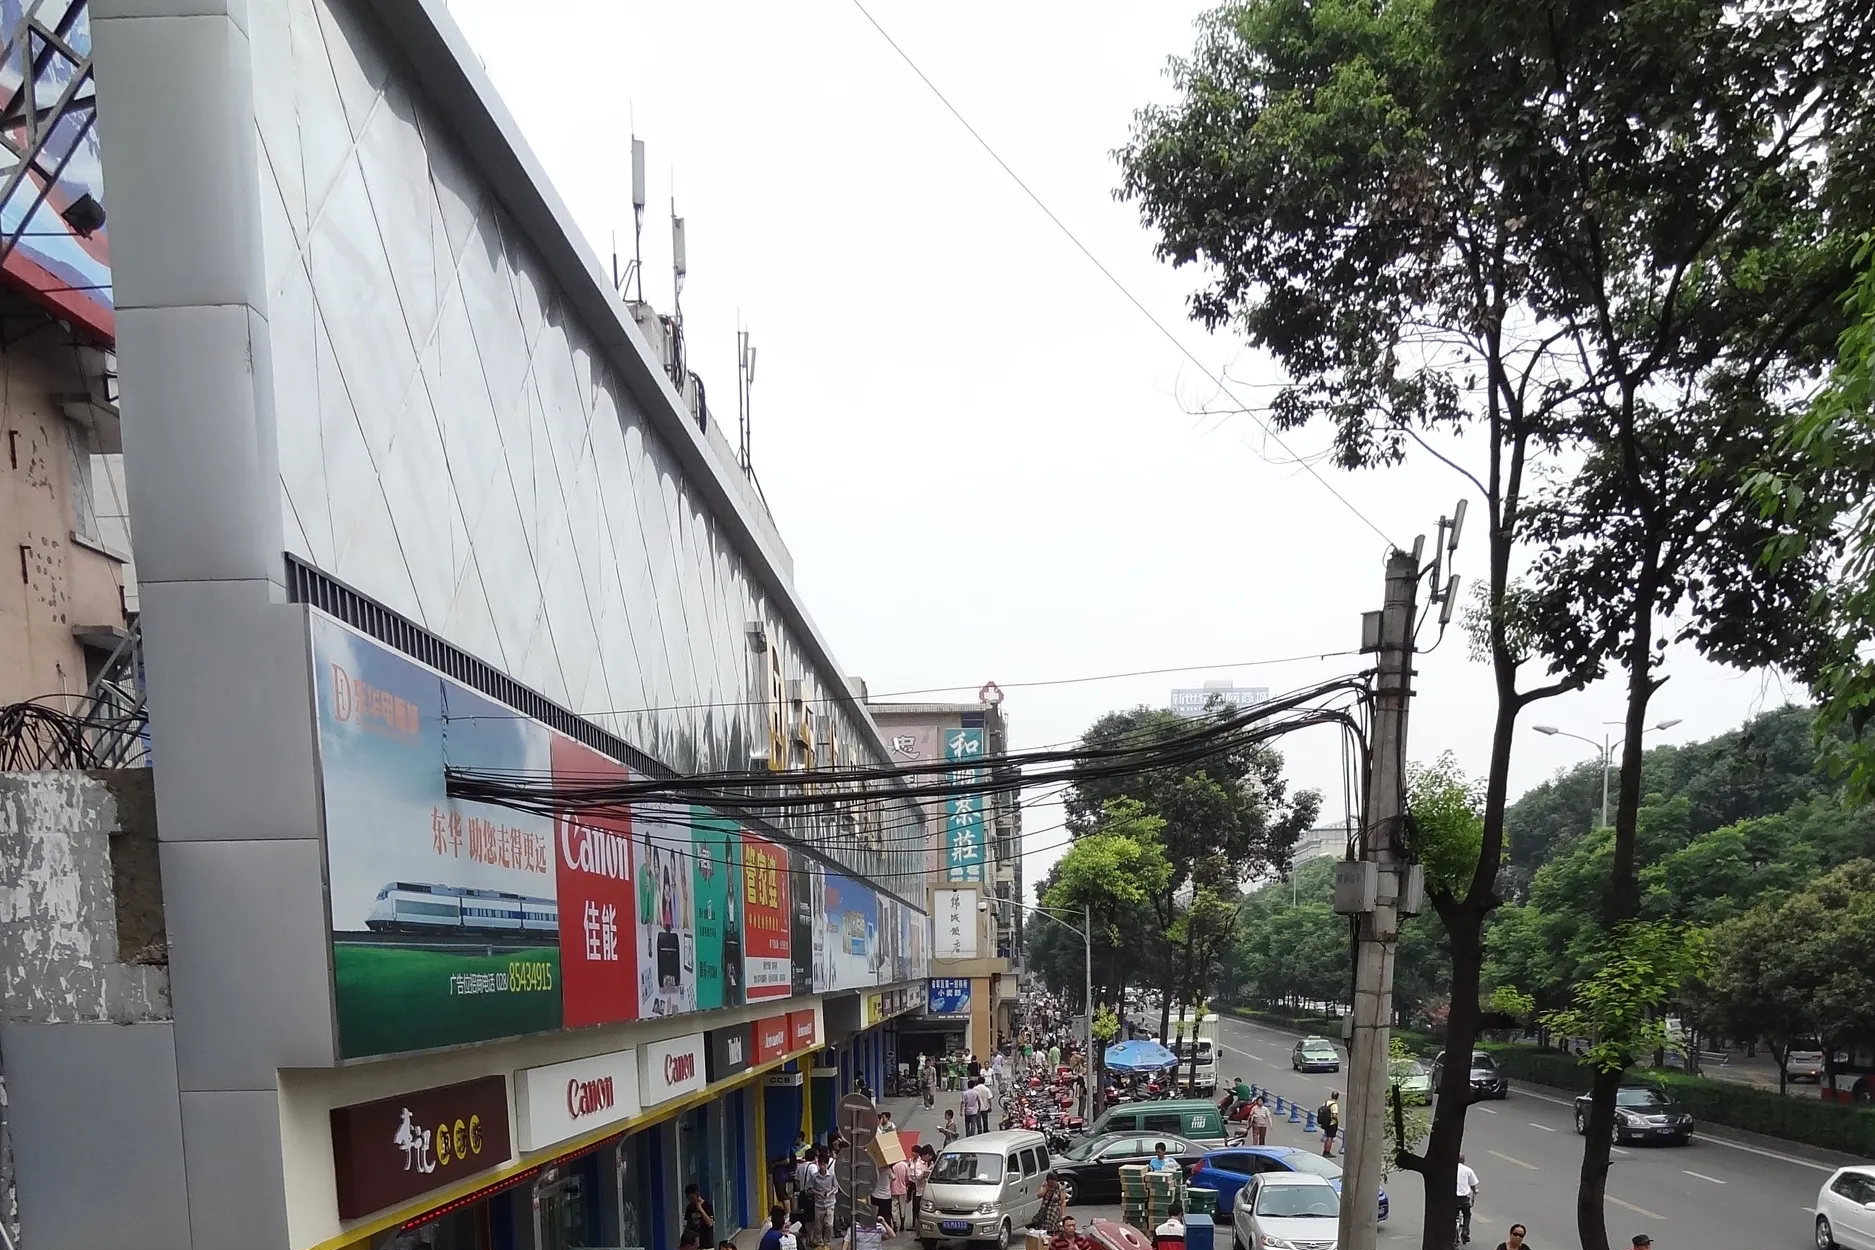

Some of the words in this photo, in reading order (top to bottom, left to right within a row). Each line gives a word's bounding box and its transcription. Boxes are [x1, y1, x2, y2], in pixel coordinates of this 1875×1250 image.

[431, 805, 464, 859] 东华
[468, 816, 547, 874] 助您走得更远
[561, 808, 630, 881] Canon
[584, 899, 619, 961] 佳能
[566, 1075, 615, 1121] Canon
[664, 1052, 696, 1087] Canon
